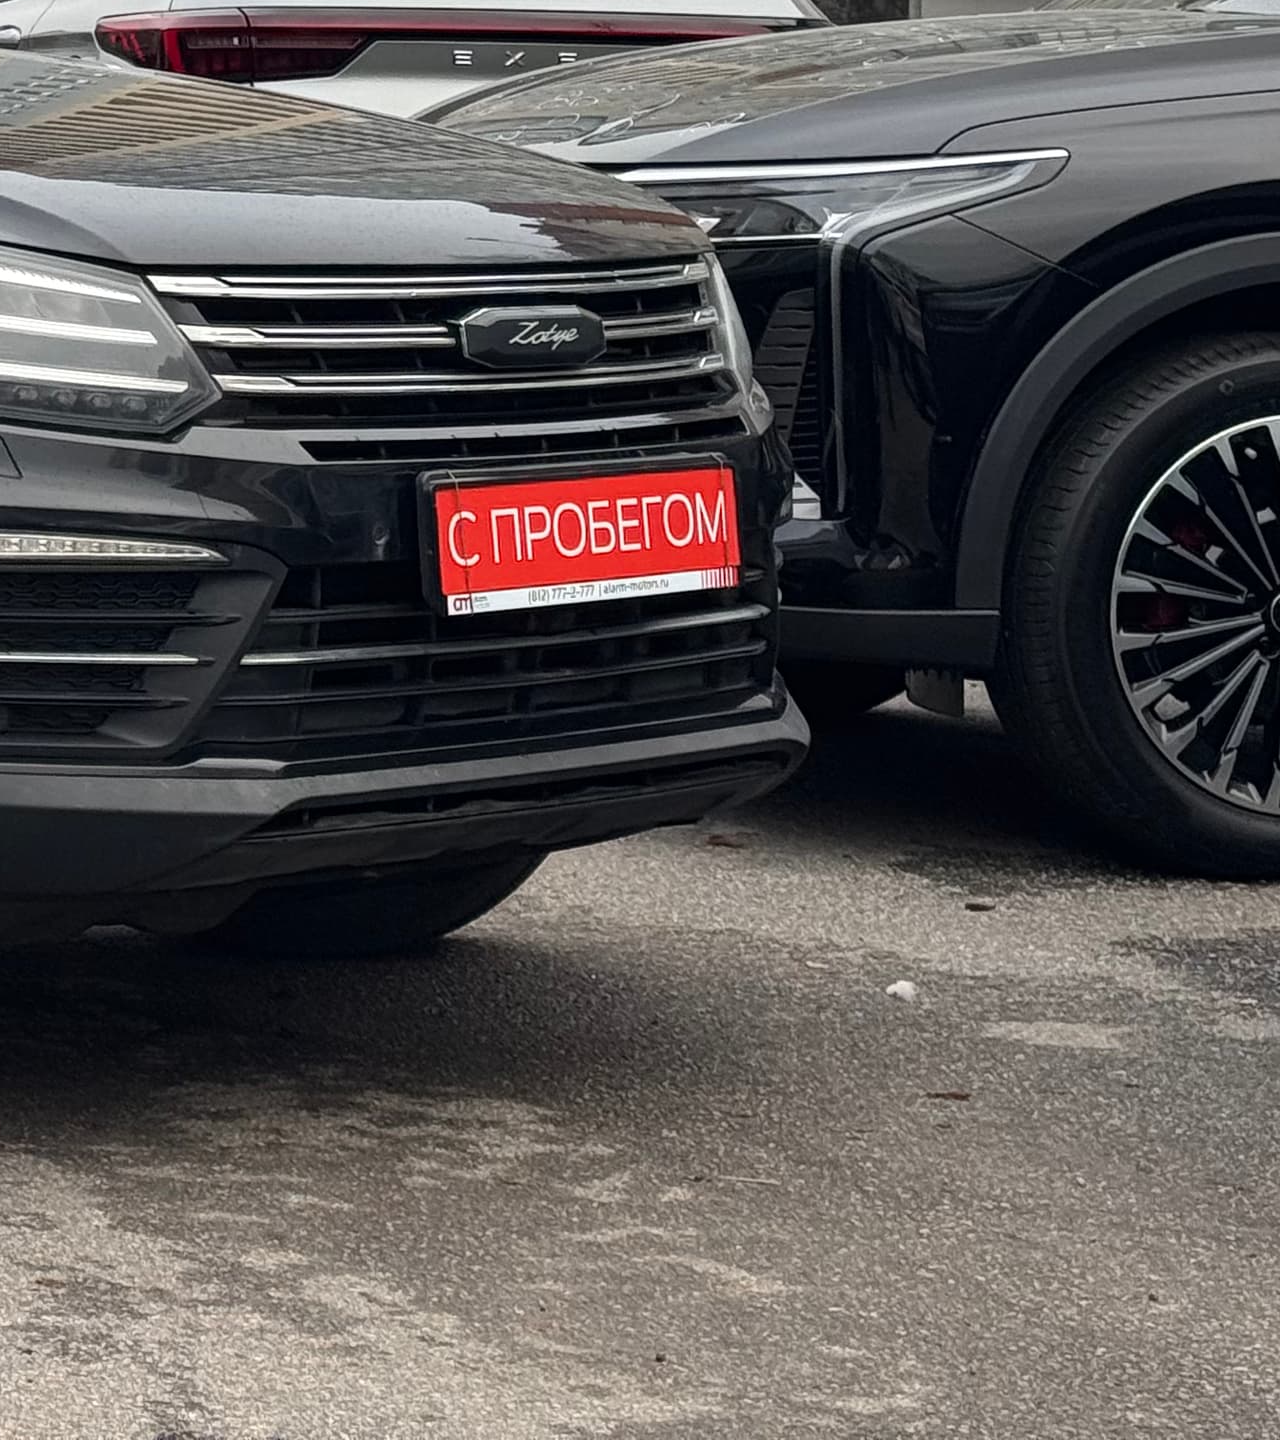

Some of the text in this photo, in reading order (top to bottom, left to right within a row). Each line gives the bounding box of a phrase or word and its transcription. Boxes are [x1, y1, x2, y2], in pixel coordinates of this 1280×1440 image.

[508, 320, 580, 351] Zotye
[447, 490, 729, 567] С ПРОБЕГОМ
